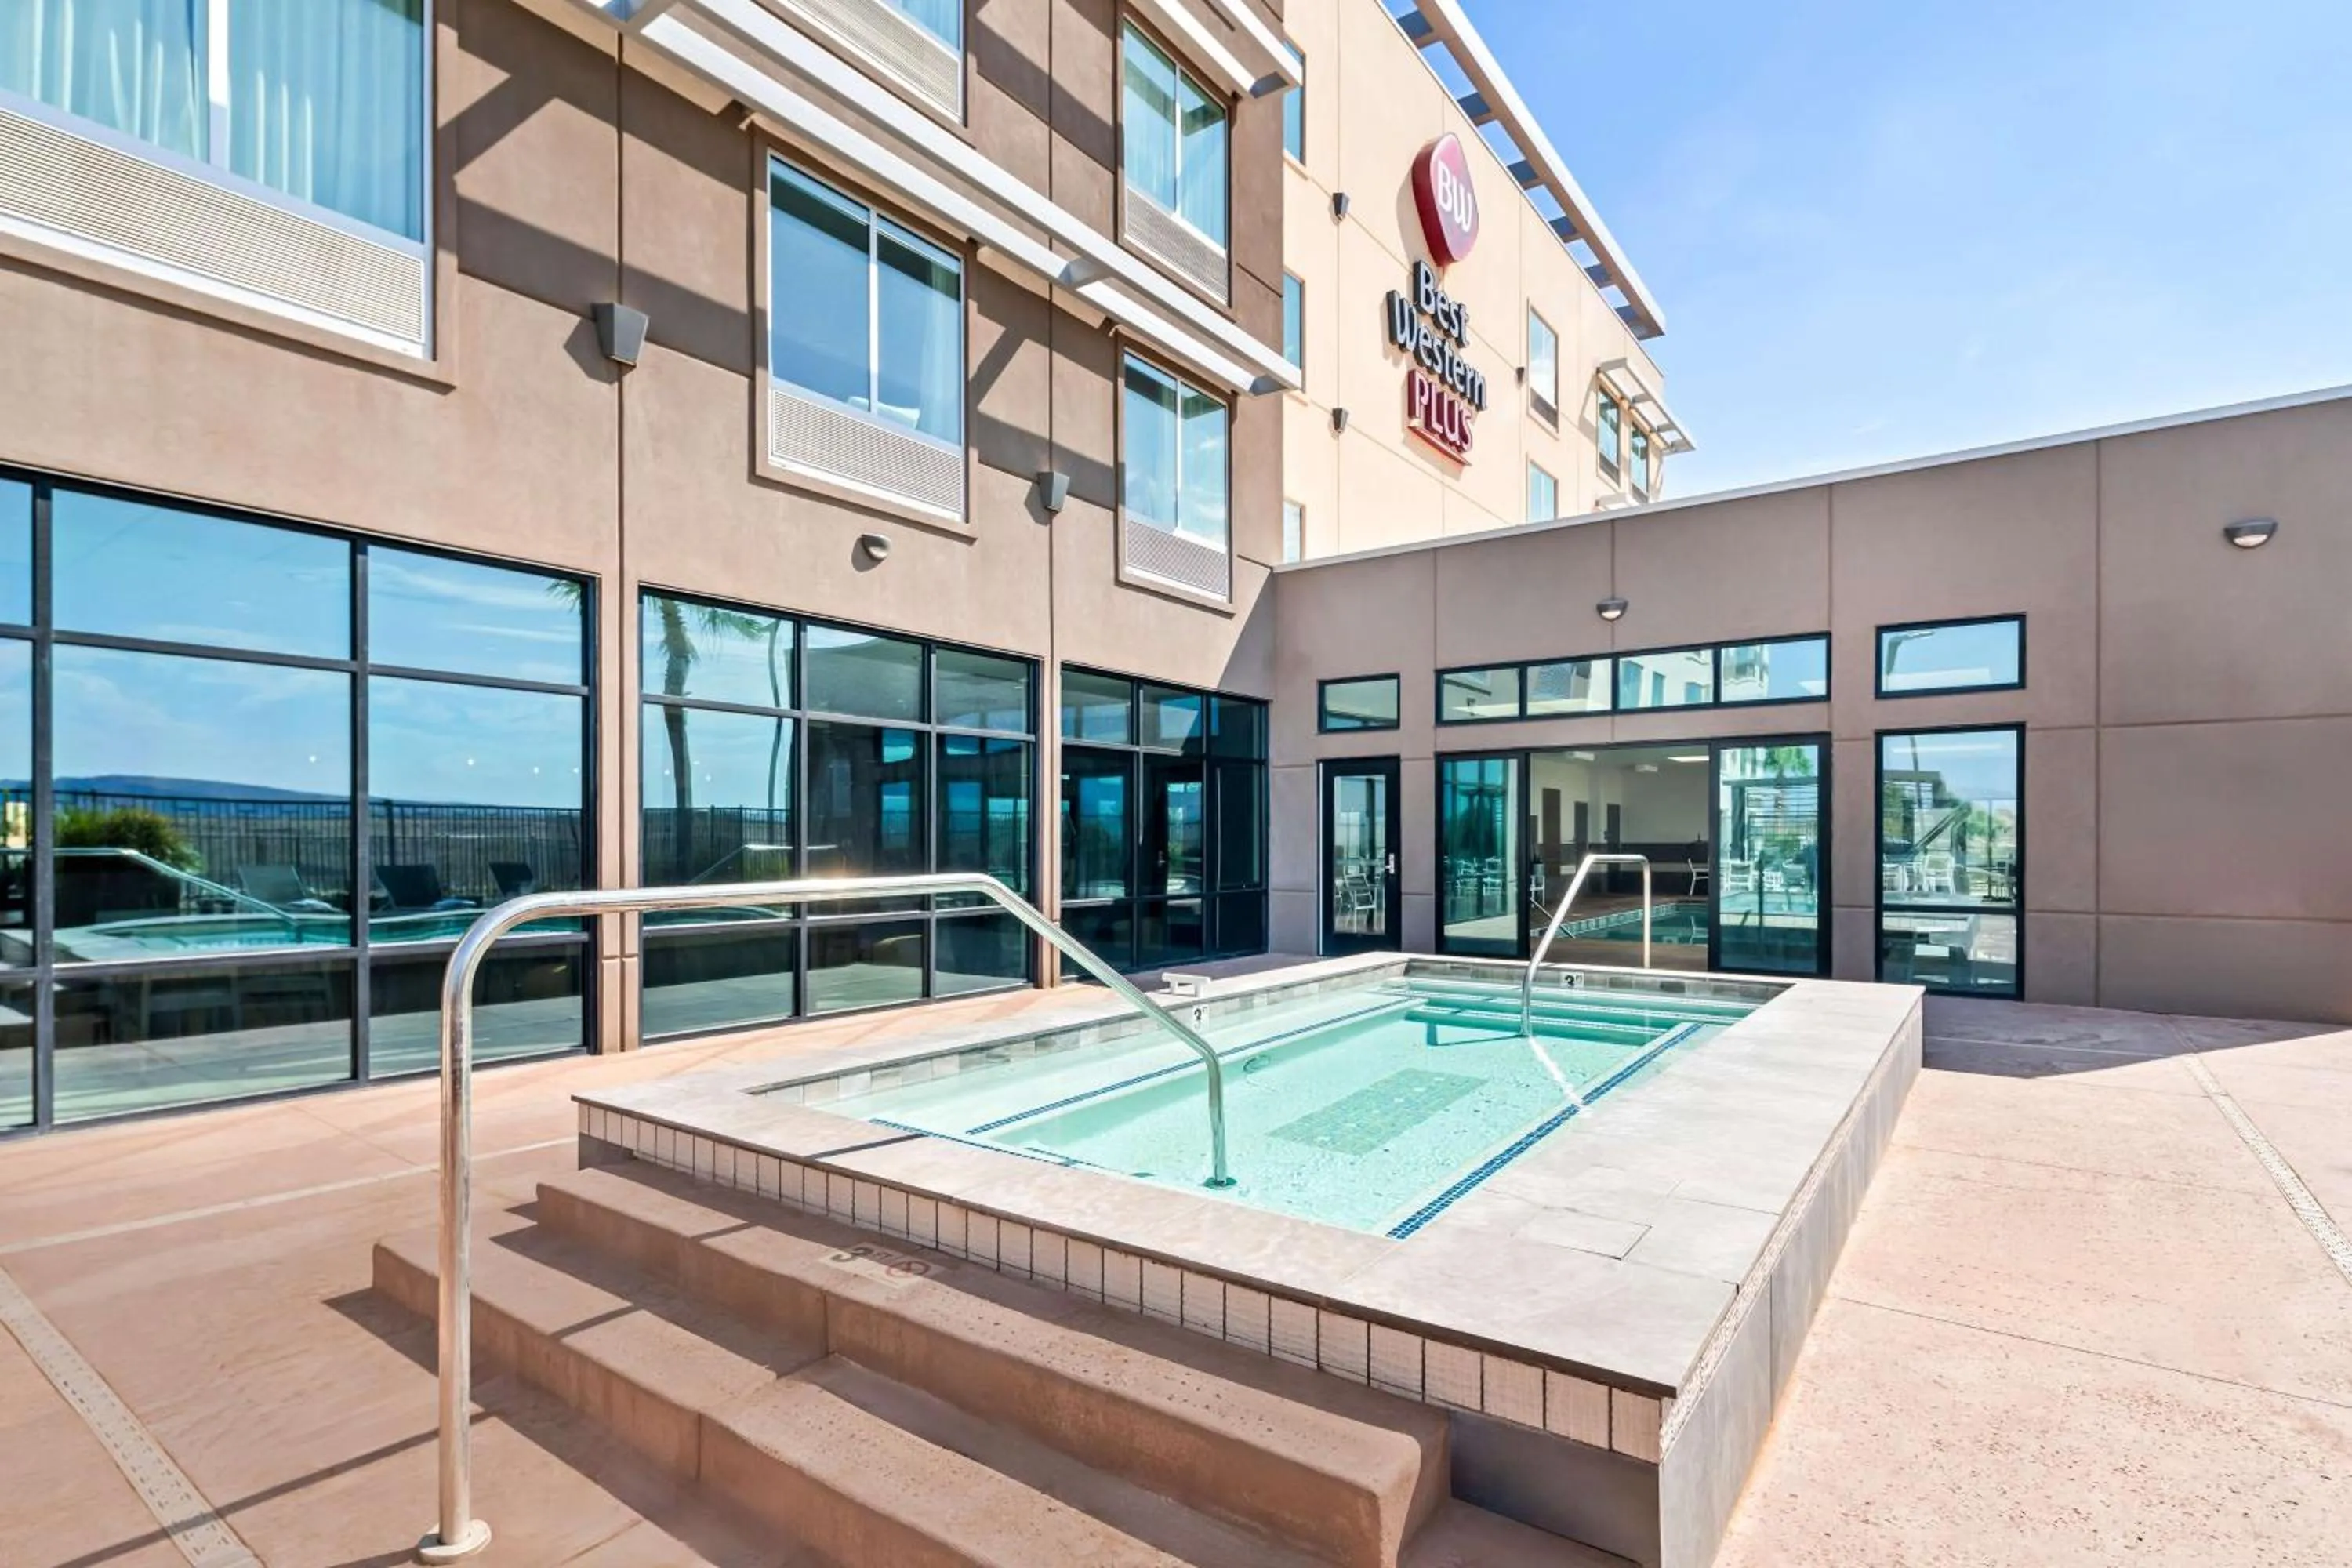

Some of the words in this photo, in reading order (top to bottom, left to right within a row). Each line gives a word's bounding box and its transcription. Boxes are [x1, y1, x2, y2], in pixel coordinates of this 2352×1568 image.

[1438, 160, 1472, 232] BW
[1414, 260, 1469, 348] Best
[1387, 289, 1487, 411] Western
[1407, 368, 1473, 453] PLUS
